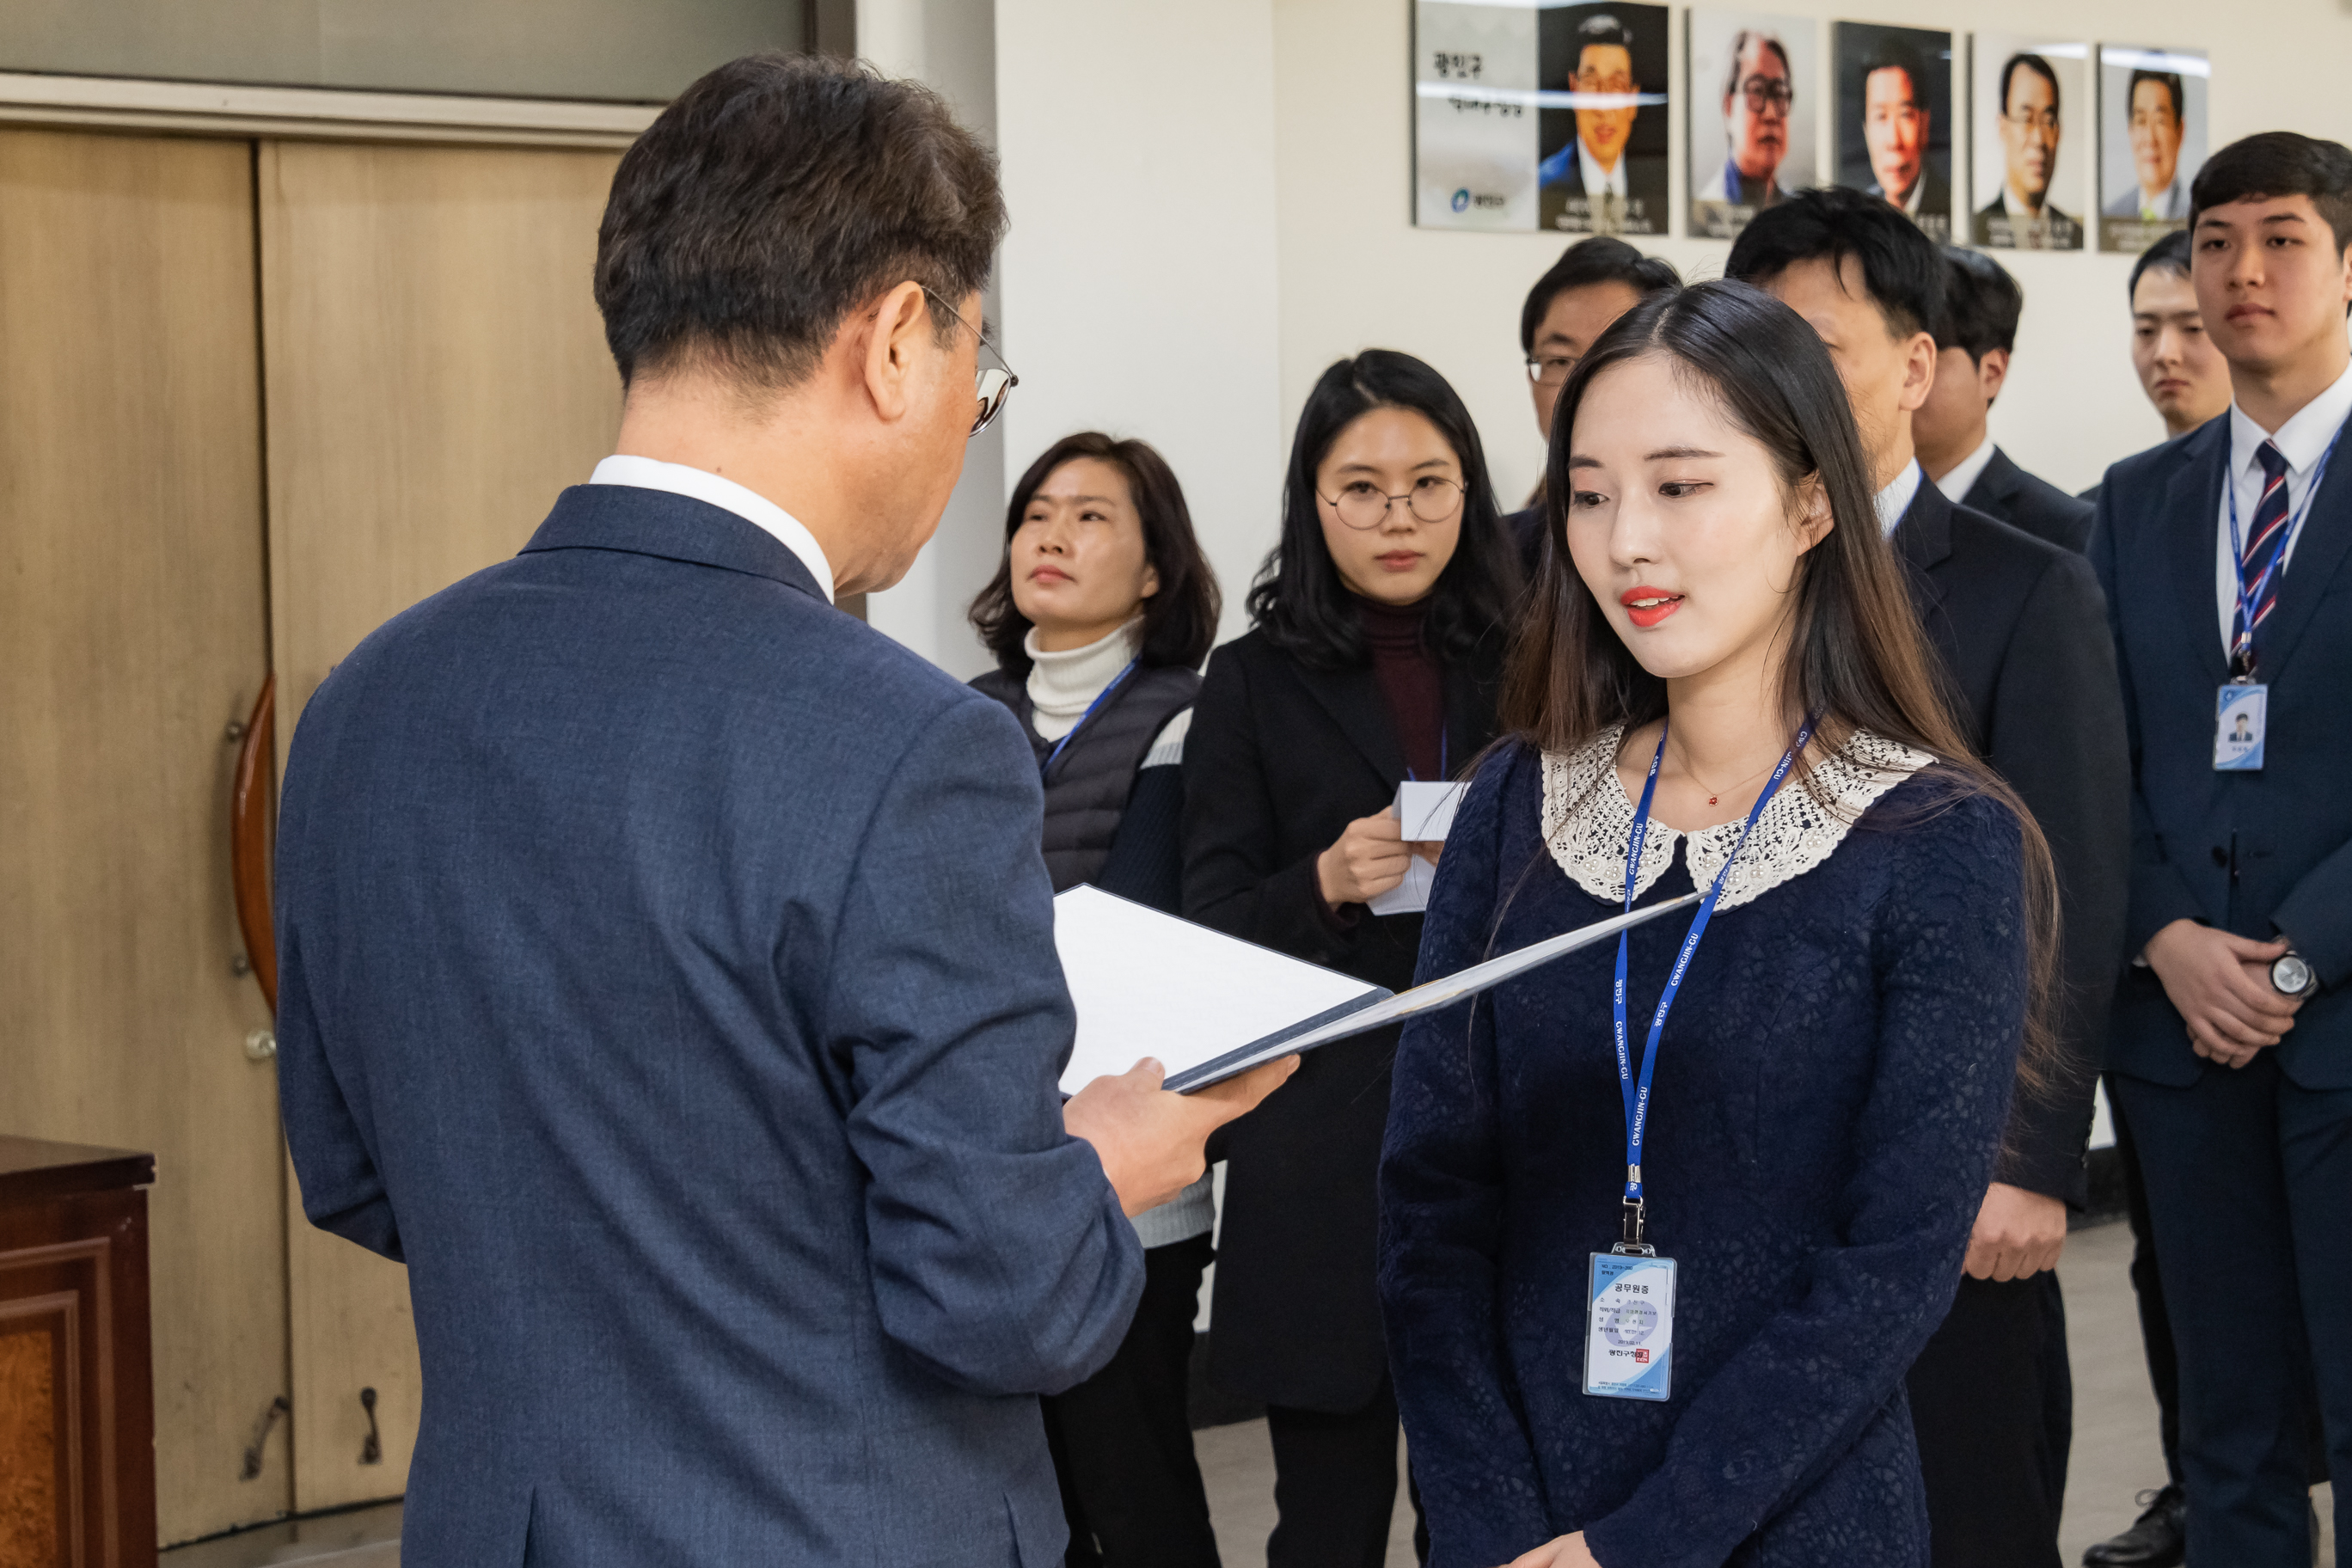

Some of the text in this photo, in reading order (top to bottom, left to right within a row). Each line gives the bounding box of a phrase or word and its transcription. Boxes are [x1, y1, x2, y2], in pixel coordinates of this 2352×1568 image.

[1628, 824, 1644, 875] GWANGJIN-GU
[1670, 933, 1699, 987] GWANGJIN-GU
[1654, 1001, 1668, 1027] 광진구
[1615, 1020, 1629, 1080] GWANGJIN-GU
[1632, 1087, 1648, 1146] GWANGJIN-GU
[1614, 1283, 1649, 1295] 공무원증
